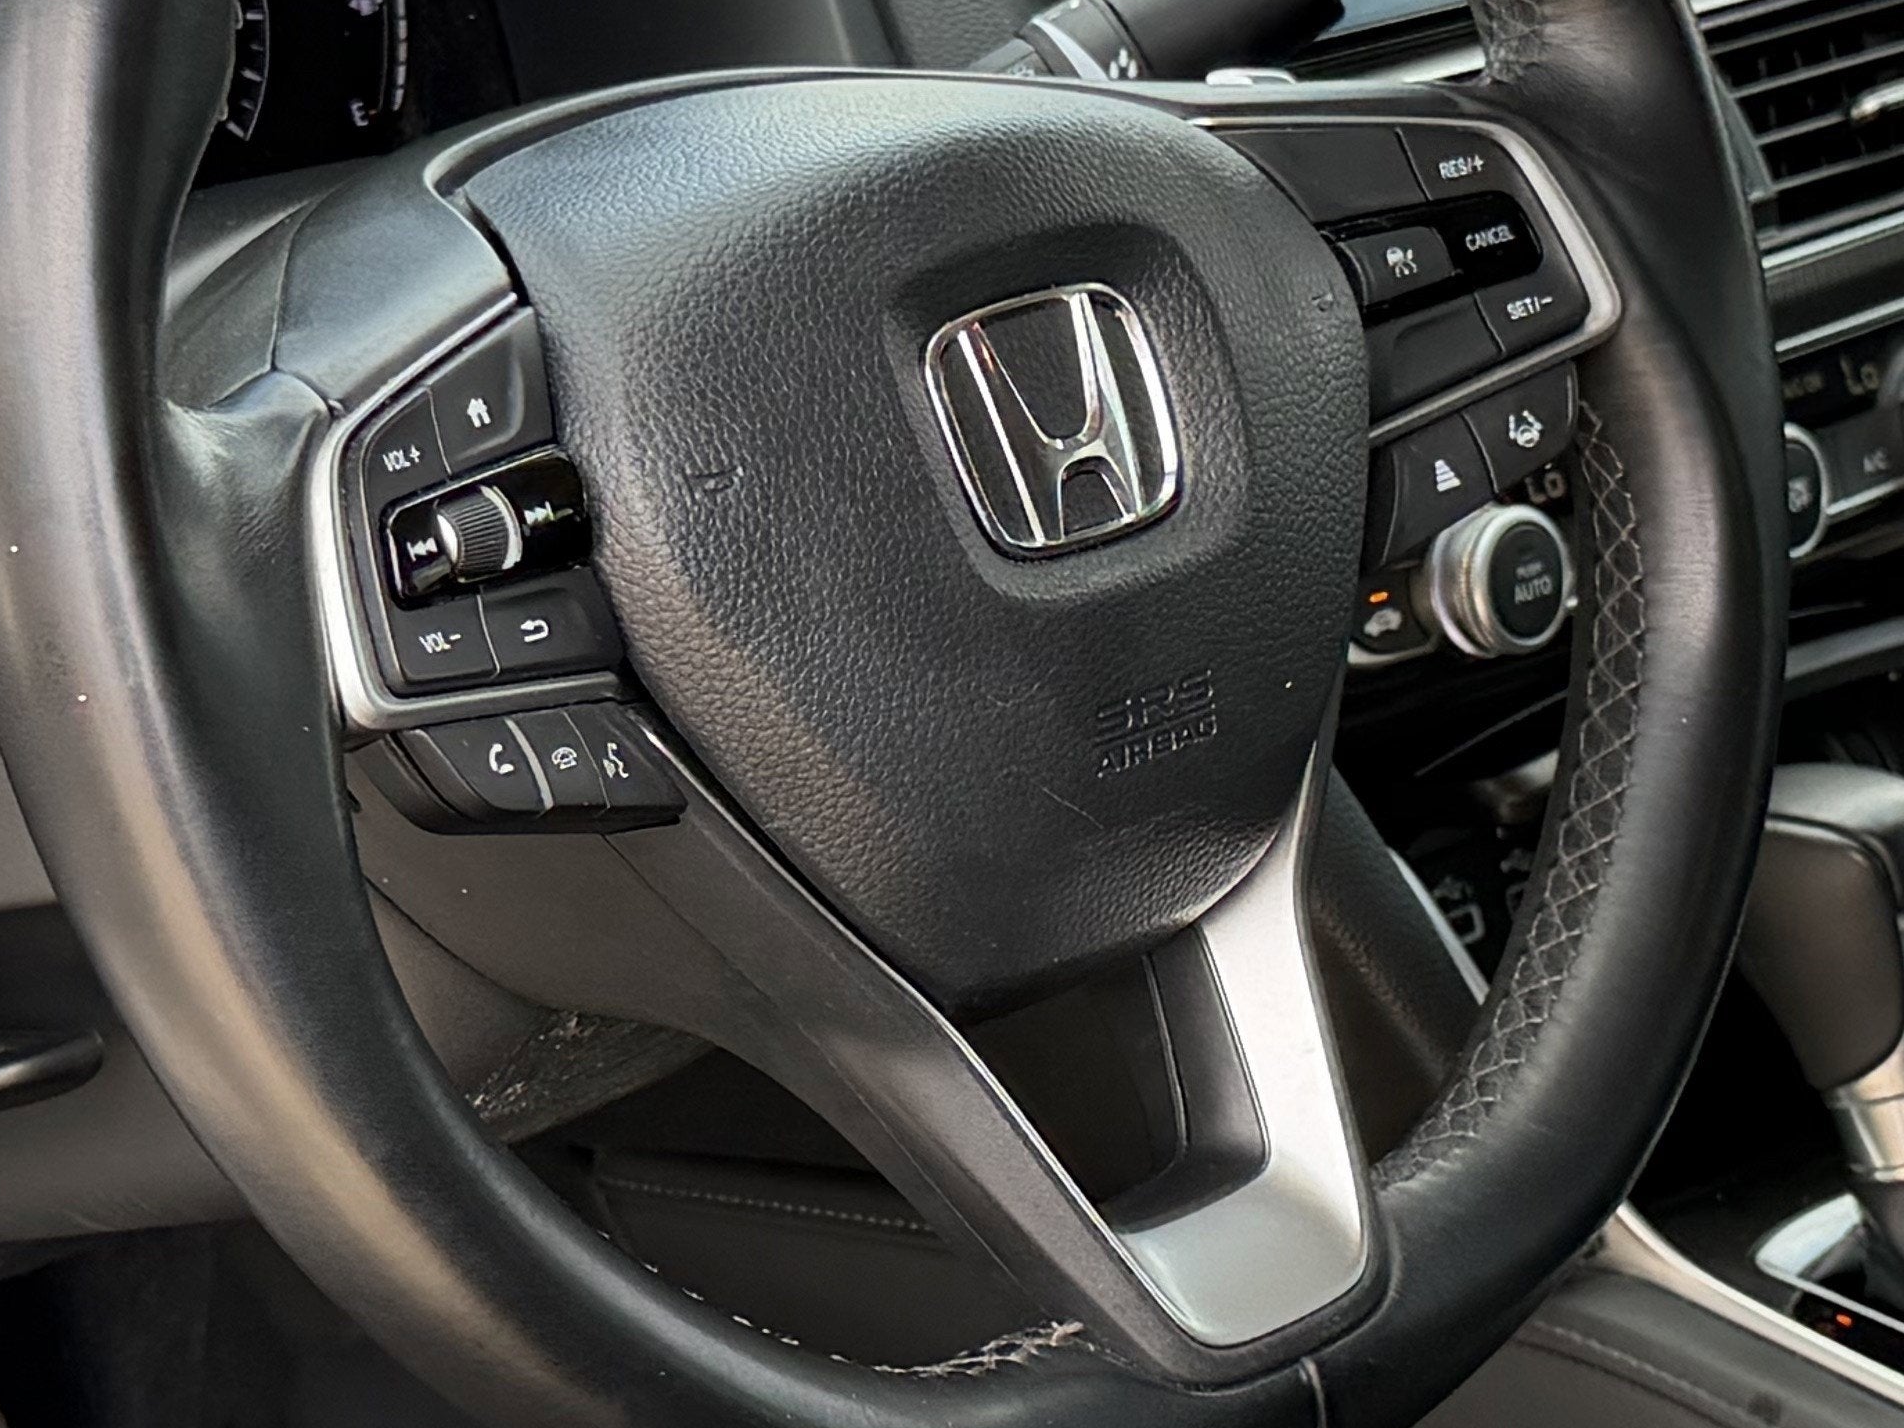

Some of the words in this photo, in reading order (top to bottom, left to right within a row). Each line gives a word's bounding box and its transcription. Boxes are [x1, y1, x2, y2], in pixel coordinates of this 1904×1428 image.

[348, 96, 370, 127] E
[1465, 223, 1516, 251] CANCEL
[1514, 573, 1554, 606] AUTO
